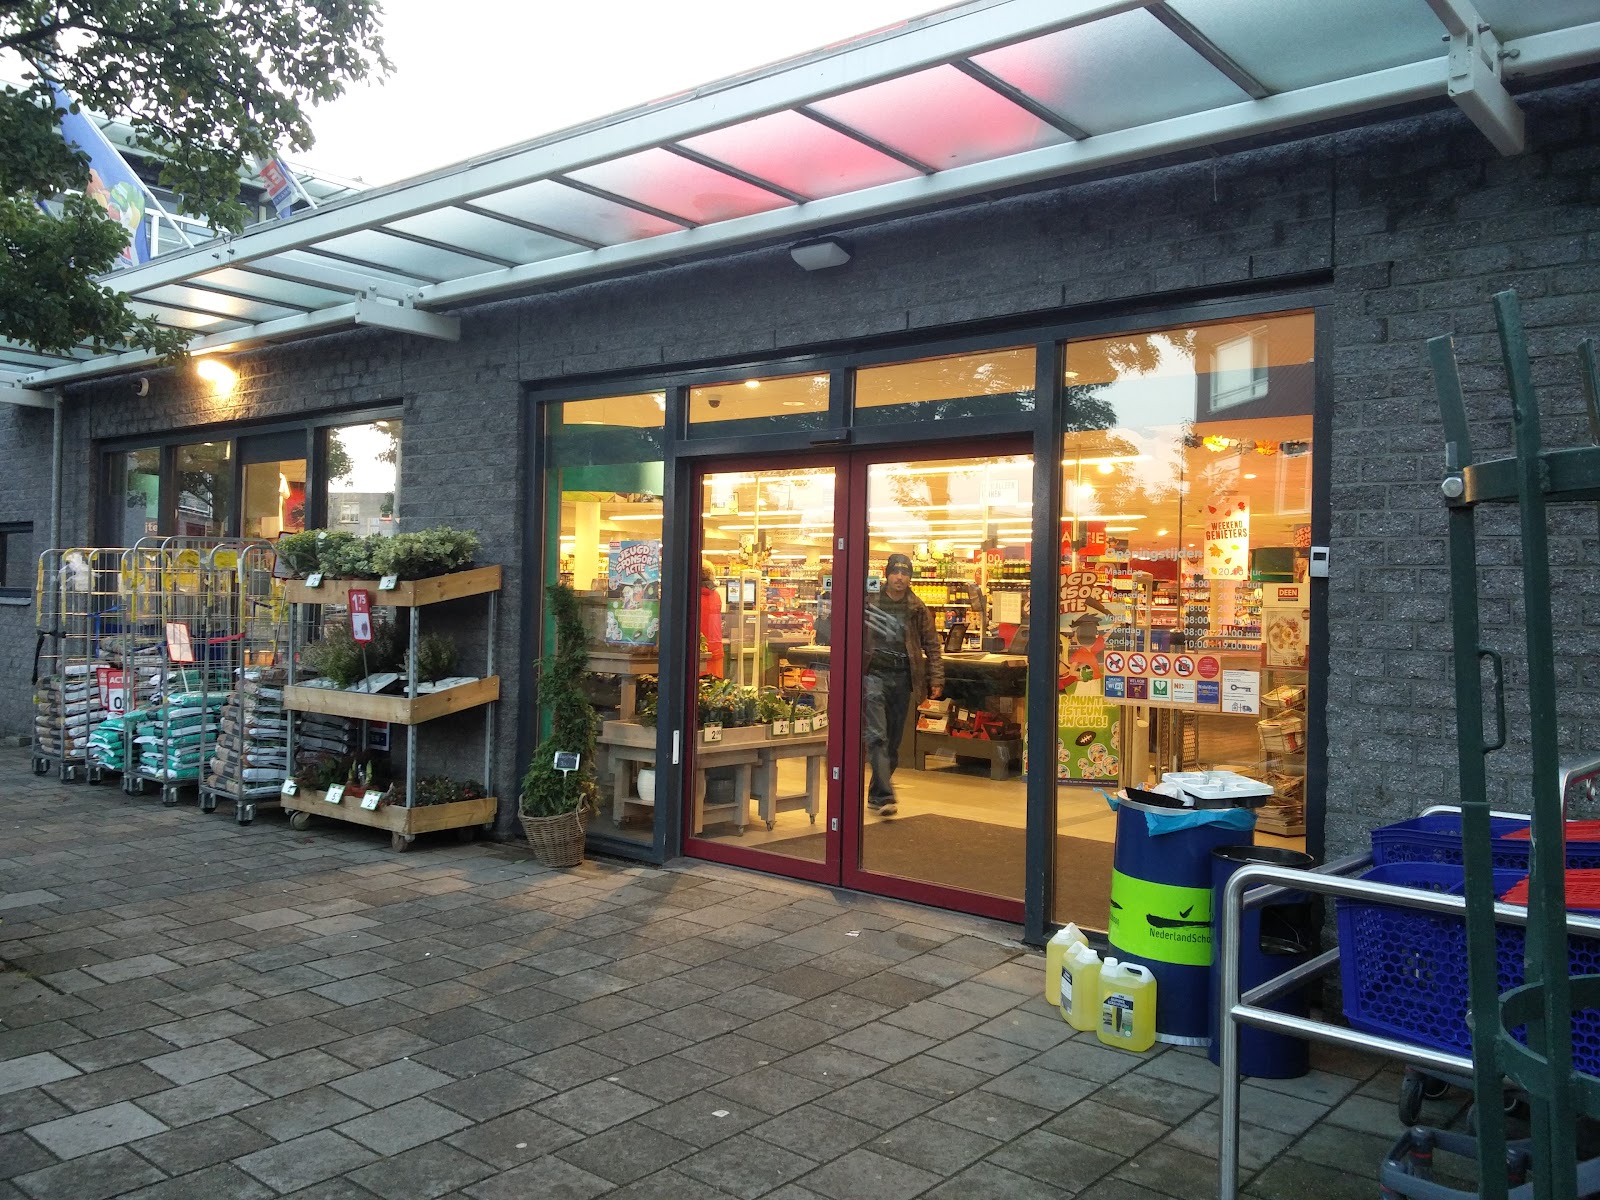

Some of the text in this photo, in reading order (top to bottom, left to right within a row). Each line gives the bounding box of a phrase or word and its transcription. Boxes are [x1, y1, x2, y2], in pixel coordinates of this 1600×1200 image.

[1211, 520, 1243, 531] WEEKEND
[1205, 528, 1248, 541] GENIETERS
[618, 544, 650, 563] JEUGD
[1105, 547, 1203, 562] Openingstijden
[615, 554, 653, 575] SPONSOR
[625, 563, 646, 577] ACTIE
[1104, 568, 1143, 577] Maandag
[1104, 591, 1148, 603] Woensdag
[1279, 588, 1298, 597] DEEN
[352, 594, 366, 611] 1.75
[1104, 614, 1133, 625] Vrijdag
[1183, 616, 1210, 625] 08:00
[1104, 626, 1142, 637] Zaterdag
[1183, 628, 1210, 637] 08:00
[1104, 637, 1135, 648] Zondag
[1183, 640, 1210, 649] 10:00
[1070, 695, 1116, 707] MUNT
[1077, 716, 1108, 728] CLUB!
[1149, 927, 1211, 944] NederlandScho
